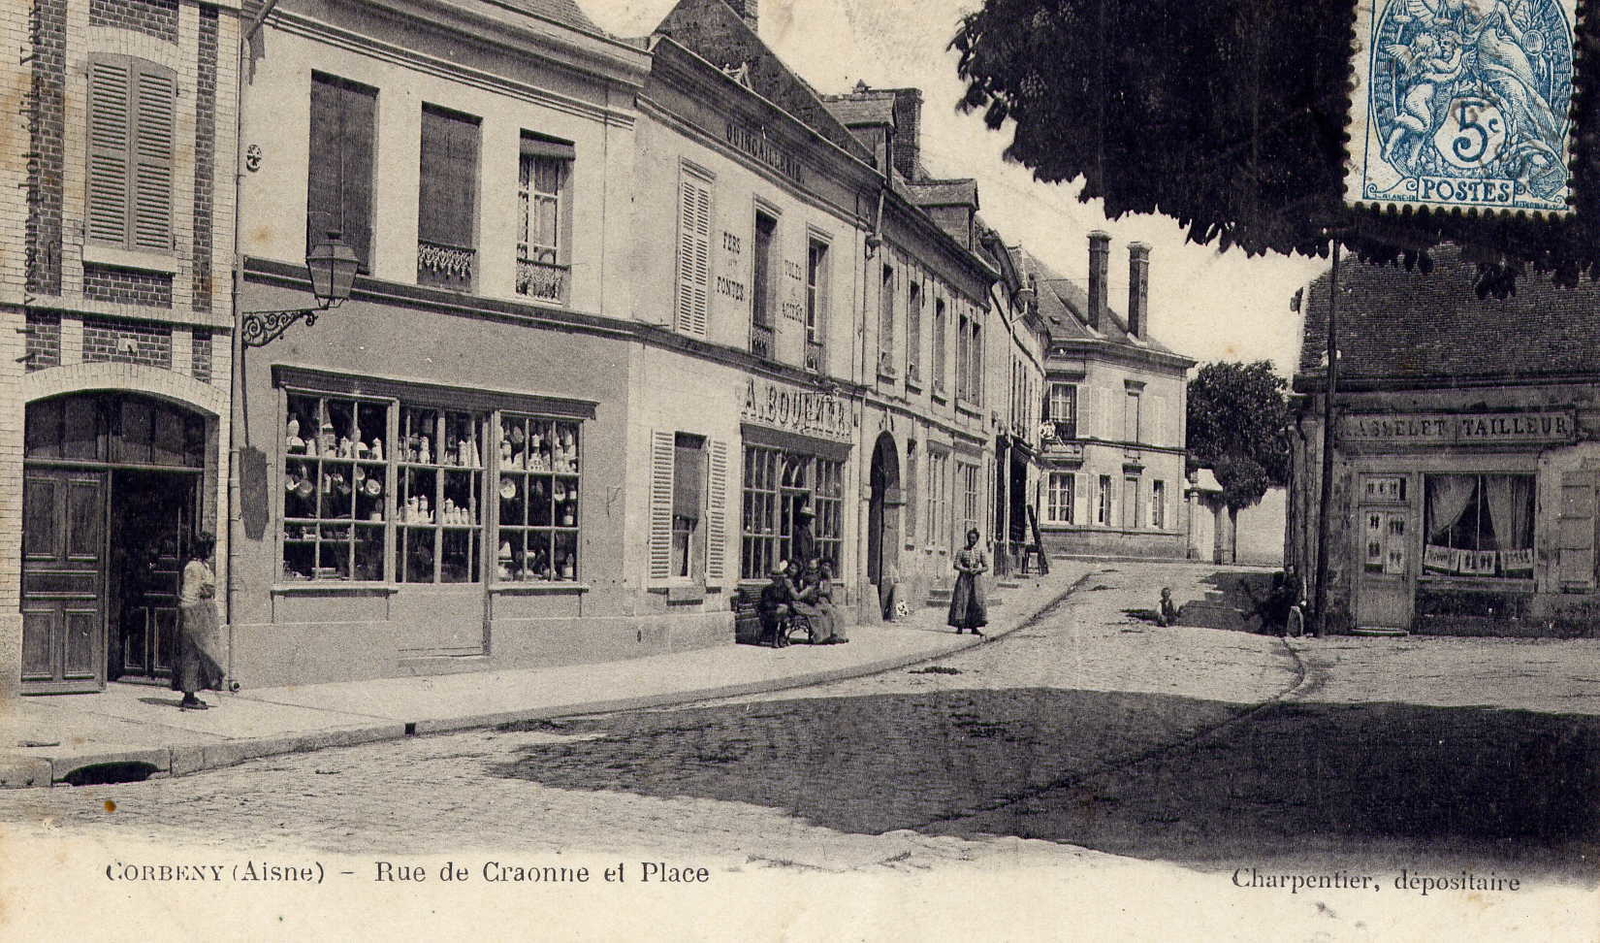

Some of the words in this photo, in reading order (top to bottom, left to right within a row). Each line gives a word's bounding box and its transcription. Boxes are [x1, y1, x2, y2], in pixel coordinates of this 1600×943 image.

[1421, 179, 1510, 203] POSTES
[722, 231, 740, 255] FERS
[1341, 420, 1447, 437] ASSELET
[1462, 416, 1567, 437] TAILLEUR
